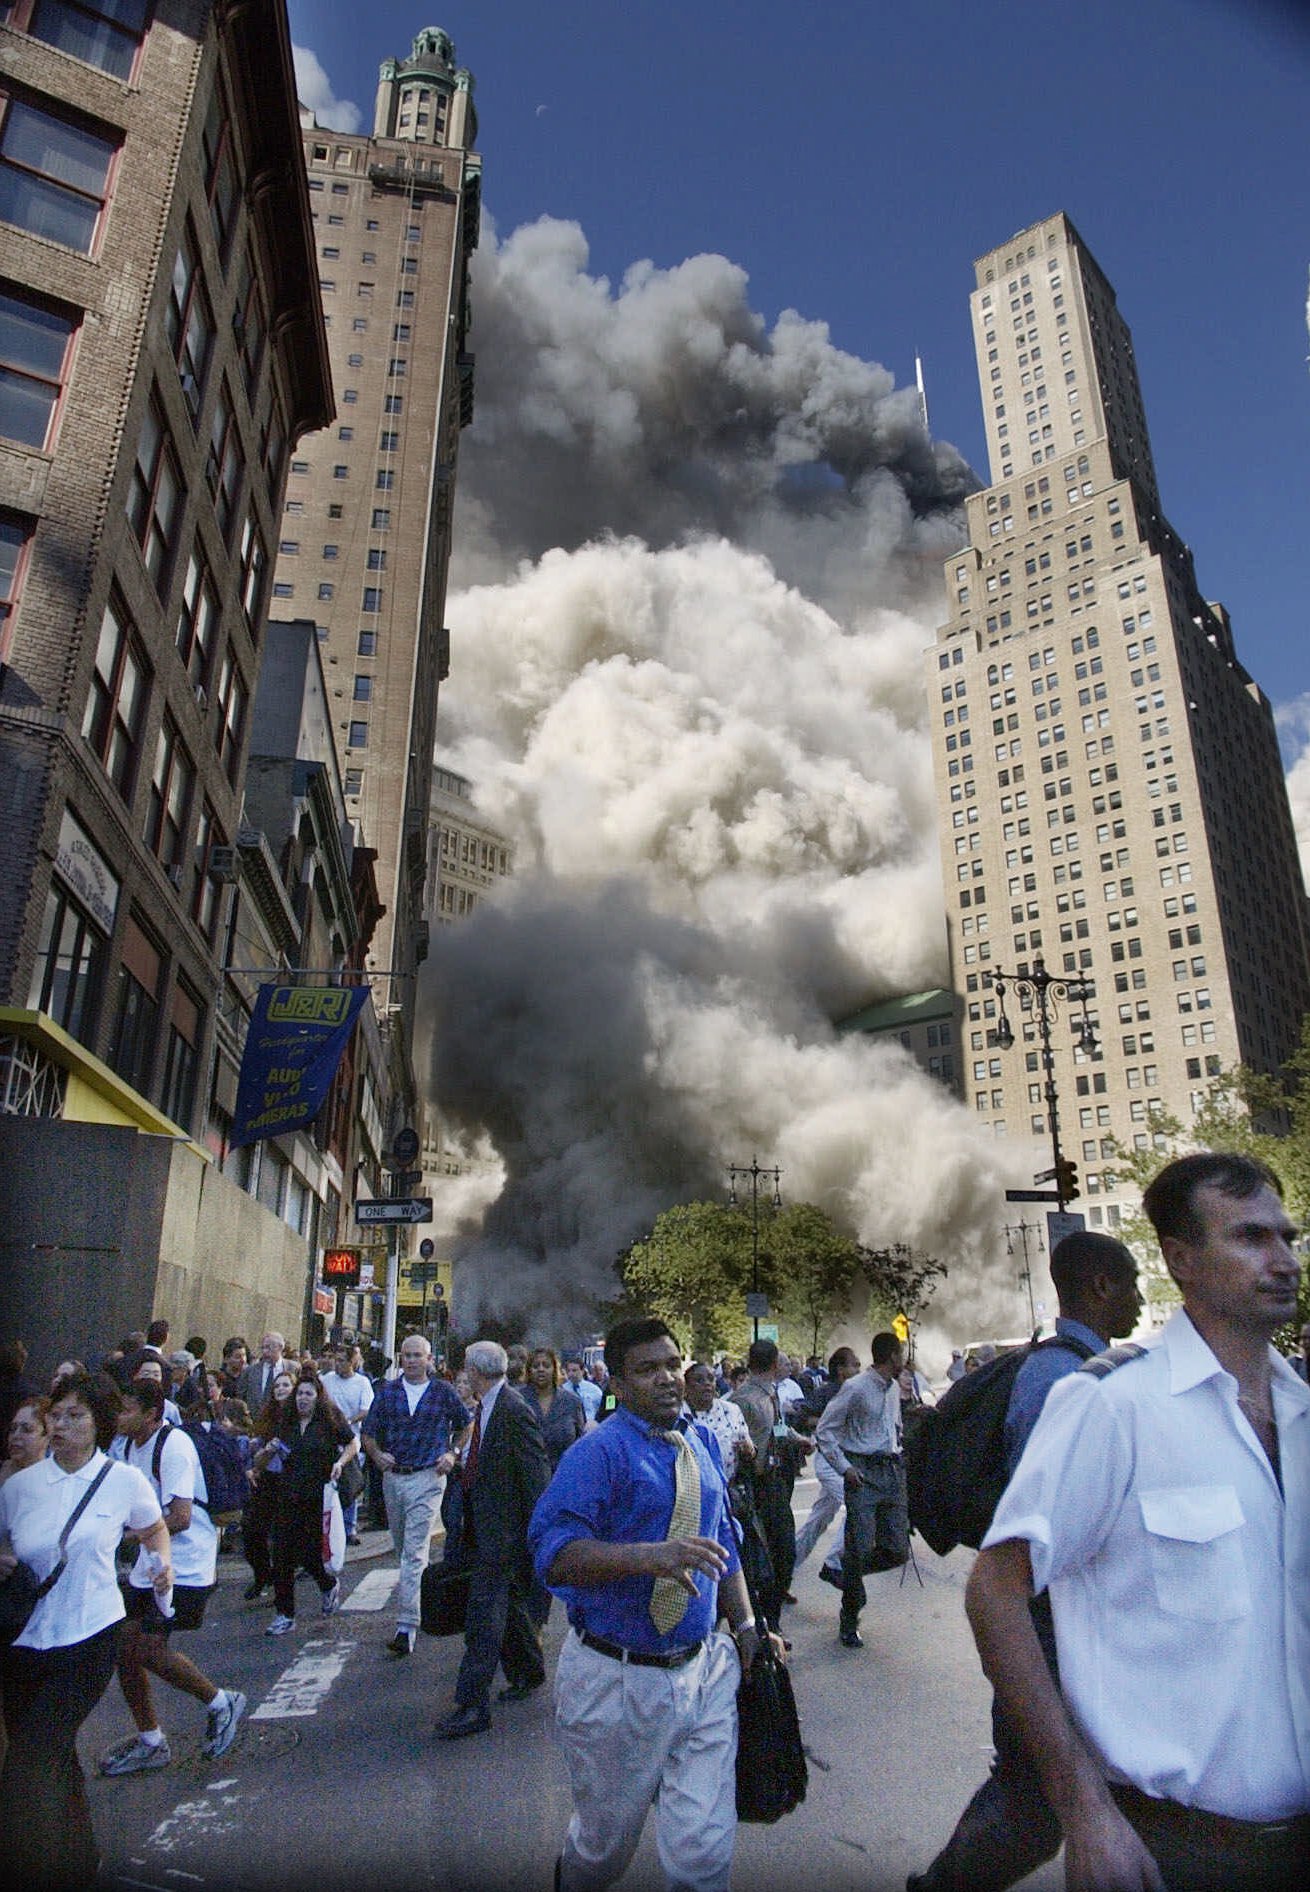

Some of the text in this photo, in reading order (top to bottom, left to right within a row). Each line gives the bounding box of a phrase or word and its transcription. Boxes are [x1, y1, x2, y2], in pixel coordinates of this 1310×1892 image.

[274, 991, 343, 1020] J&R
[365, 1205, 422, 1217] ONE WAY
